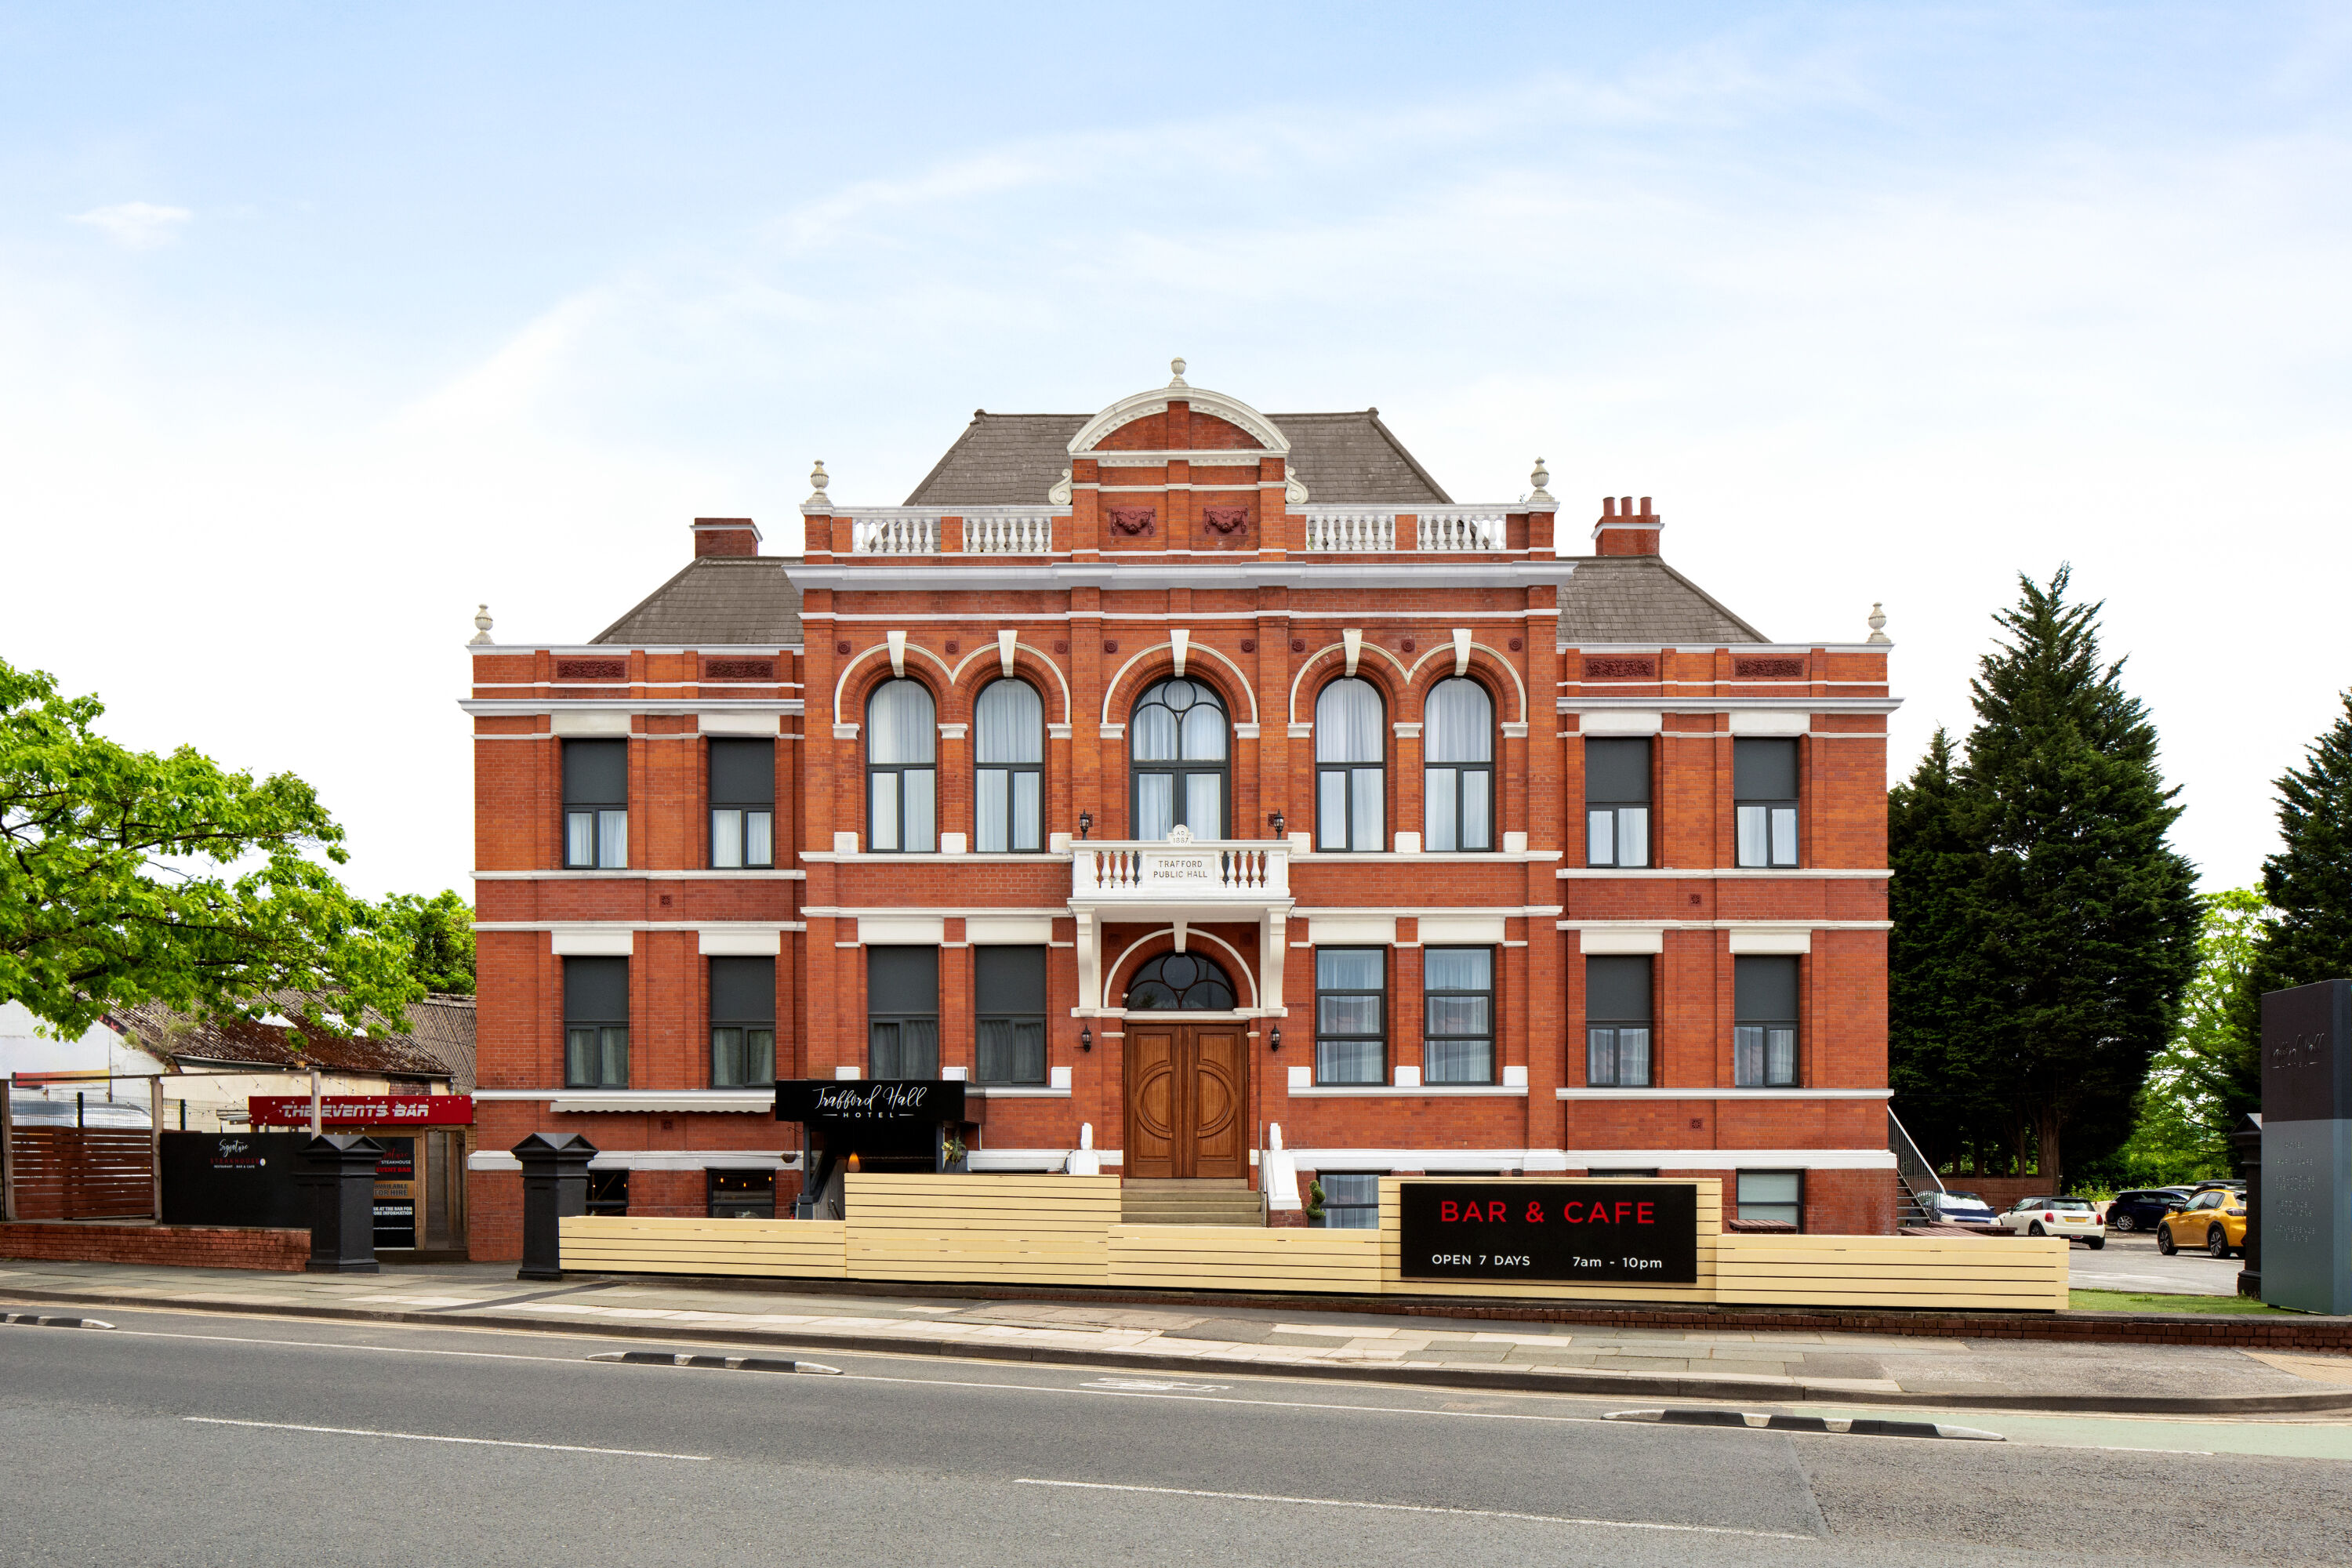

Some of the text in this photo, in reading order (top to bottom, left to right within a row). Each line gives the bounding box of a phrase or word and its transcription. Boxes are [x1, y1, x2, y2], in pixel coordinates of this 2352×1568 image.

[812, 1083, 927, 1110] Trafford Hall
[321, 1105, 389, 1117] EVENTS
[394, 1104, 430, 1117] BAR
[219, 1138, 249, 1158] Signature
[1440, 1200, 1654, 1224] BAR & CAFE
[1432, 1254, 1472, 1265] OPEN
[1479, 1255, 1486, 1265] 7
[1494, 1255, 1530, 1266] DAYS
[1573, 1257, 1602, 1267] 7am
[1622, 1257, 1662, 1269] 10pm
